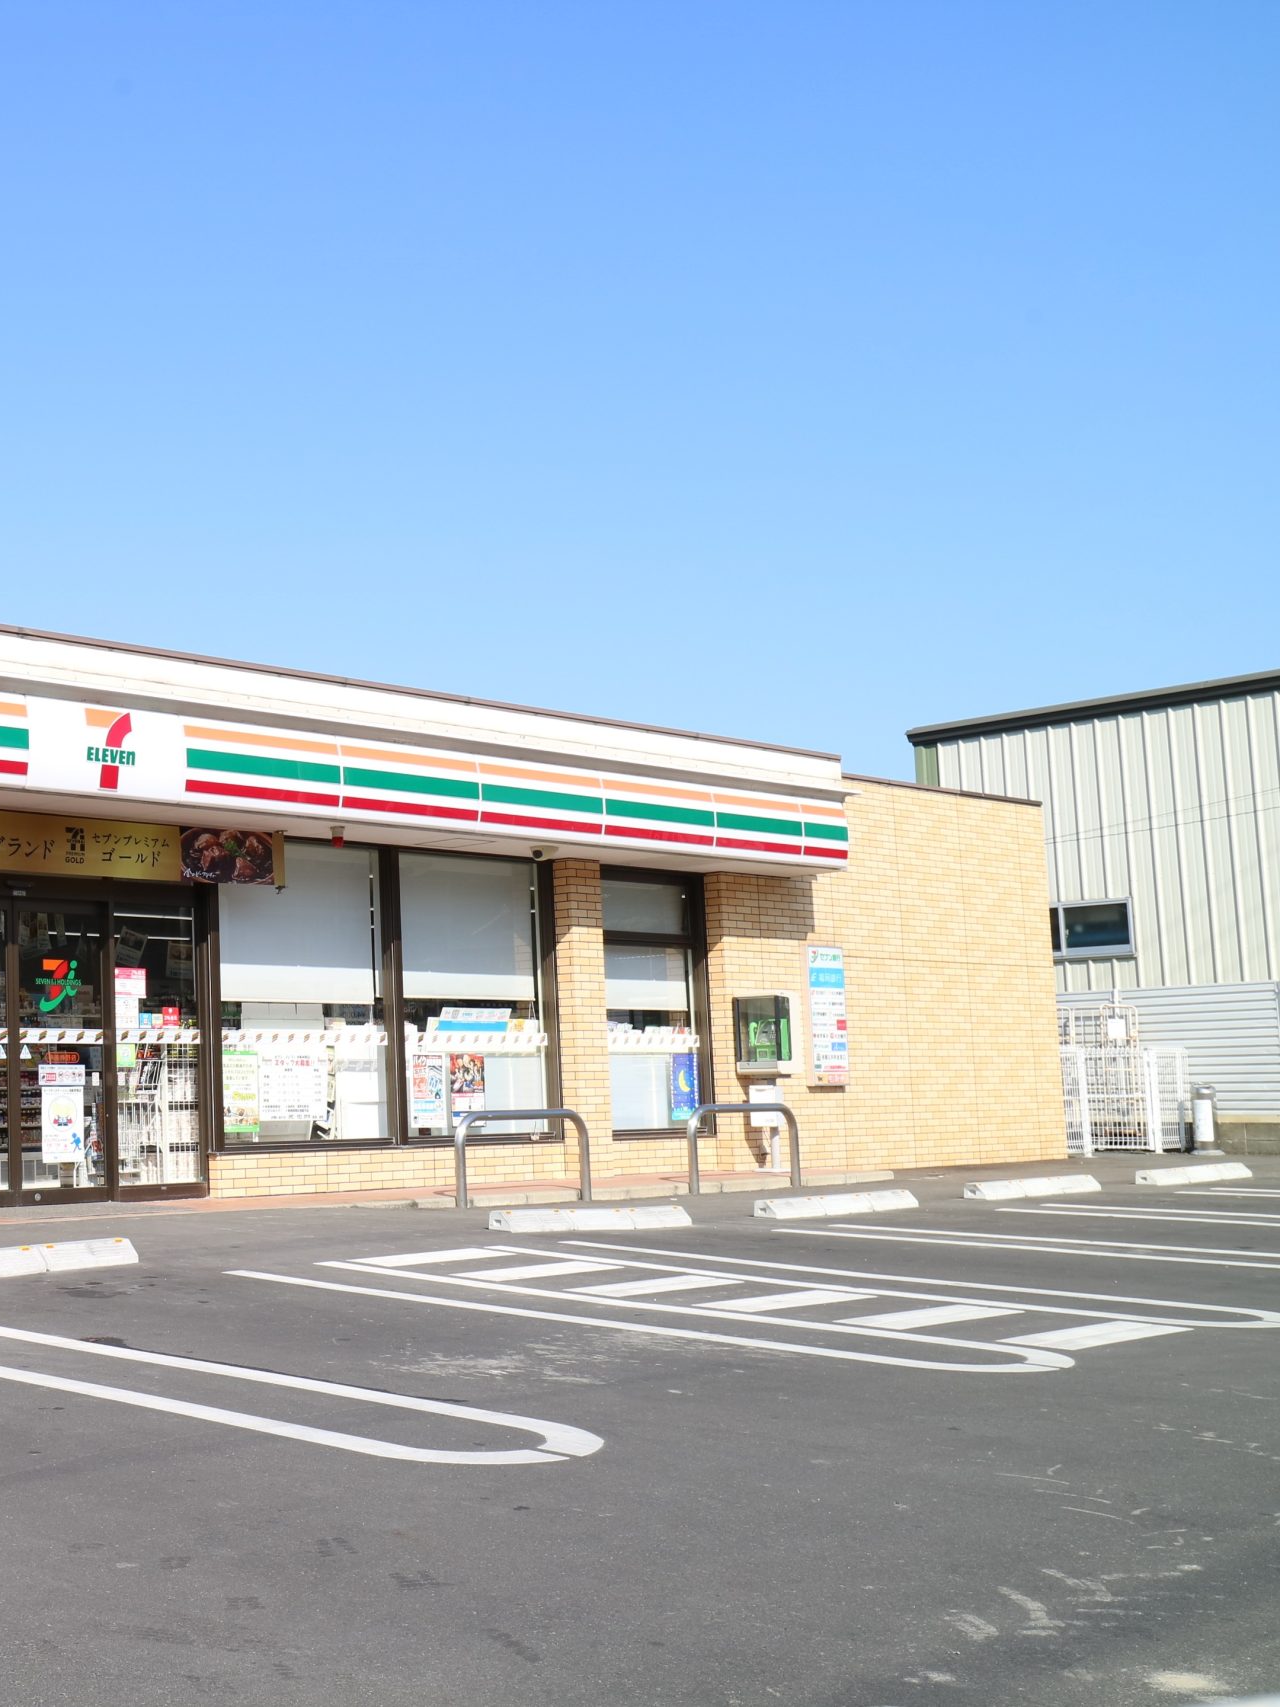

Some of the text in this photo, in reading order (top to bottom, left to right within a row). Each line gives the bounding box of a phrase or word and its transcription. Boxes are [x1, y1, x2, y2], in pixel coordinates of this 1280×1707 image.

[92, 832, 170, 848] セブンプレミアム
[65, 856, 85, 864] GOLD
[101, 848, 161, 867] ゴールド
